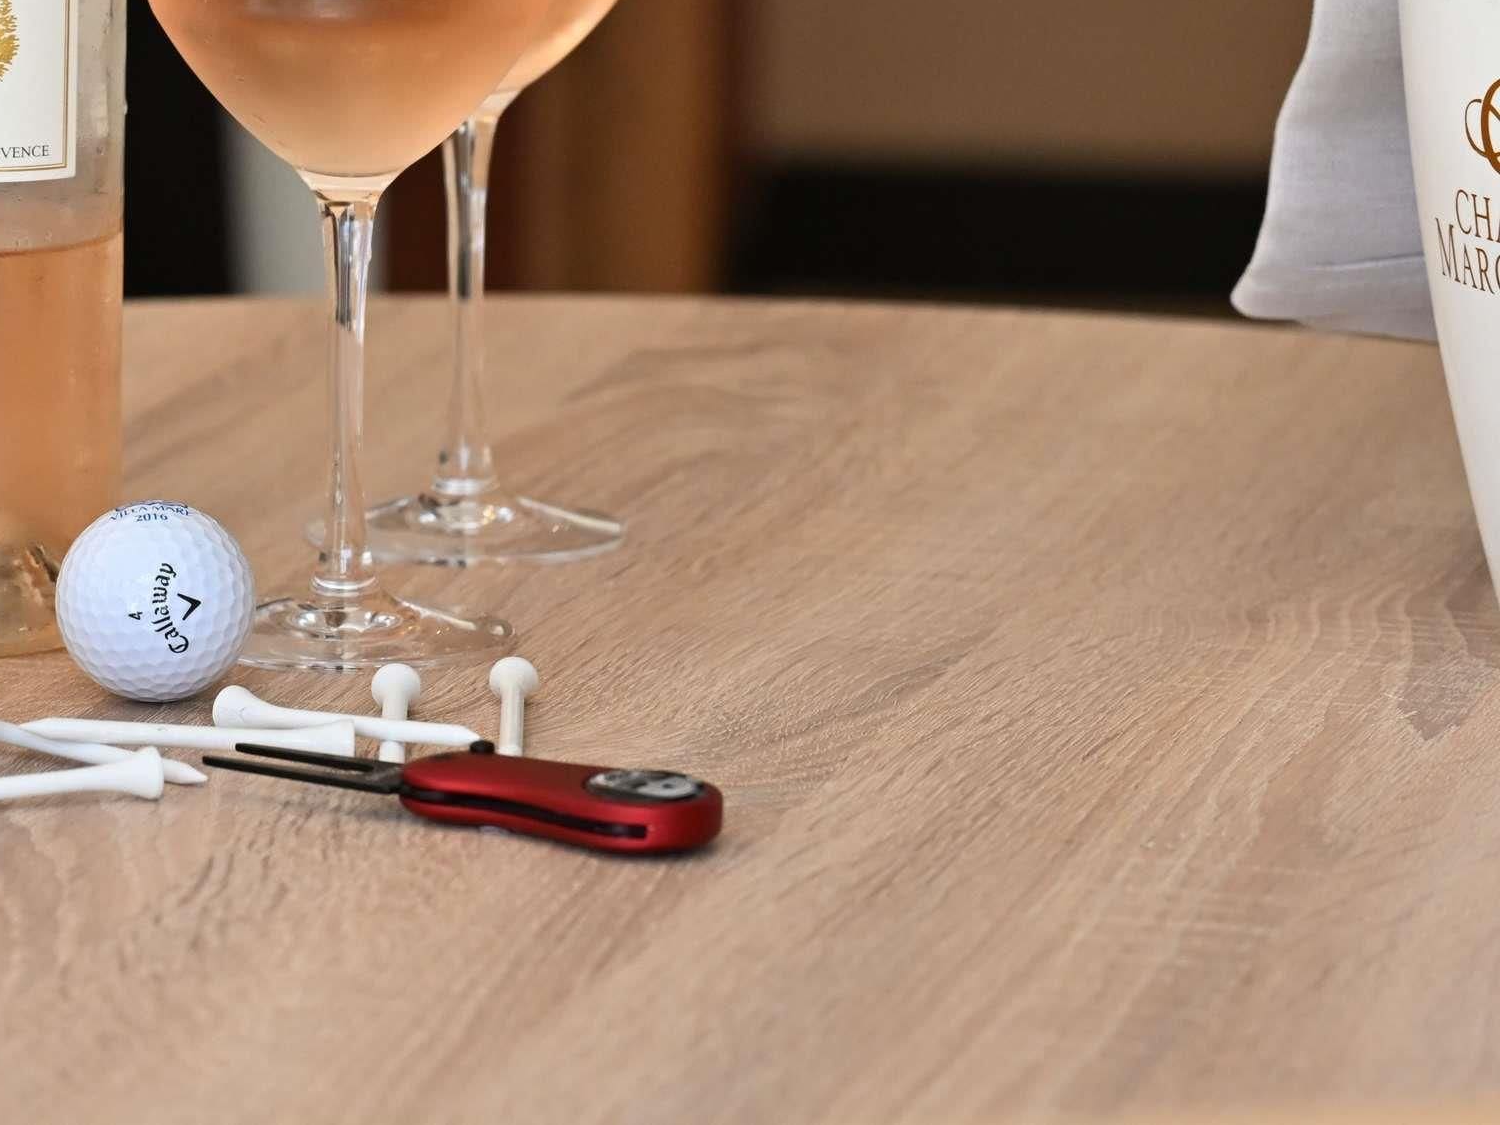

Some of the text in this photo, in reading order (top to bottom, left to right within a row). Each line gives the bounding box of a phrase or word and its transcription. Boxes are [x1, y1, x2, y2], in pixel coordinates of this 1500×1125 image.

[1455, 189, 1500, 244] CH
[136, 513, 168, 522] 2016
[128, 611, 143, 621] 4
[152, 563, 189, 653] Callaway
